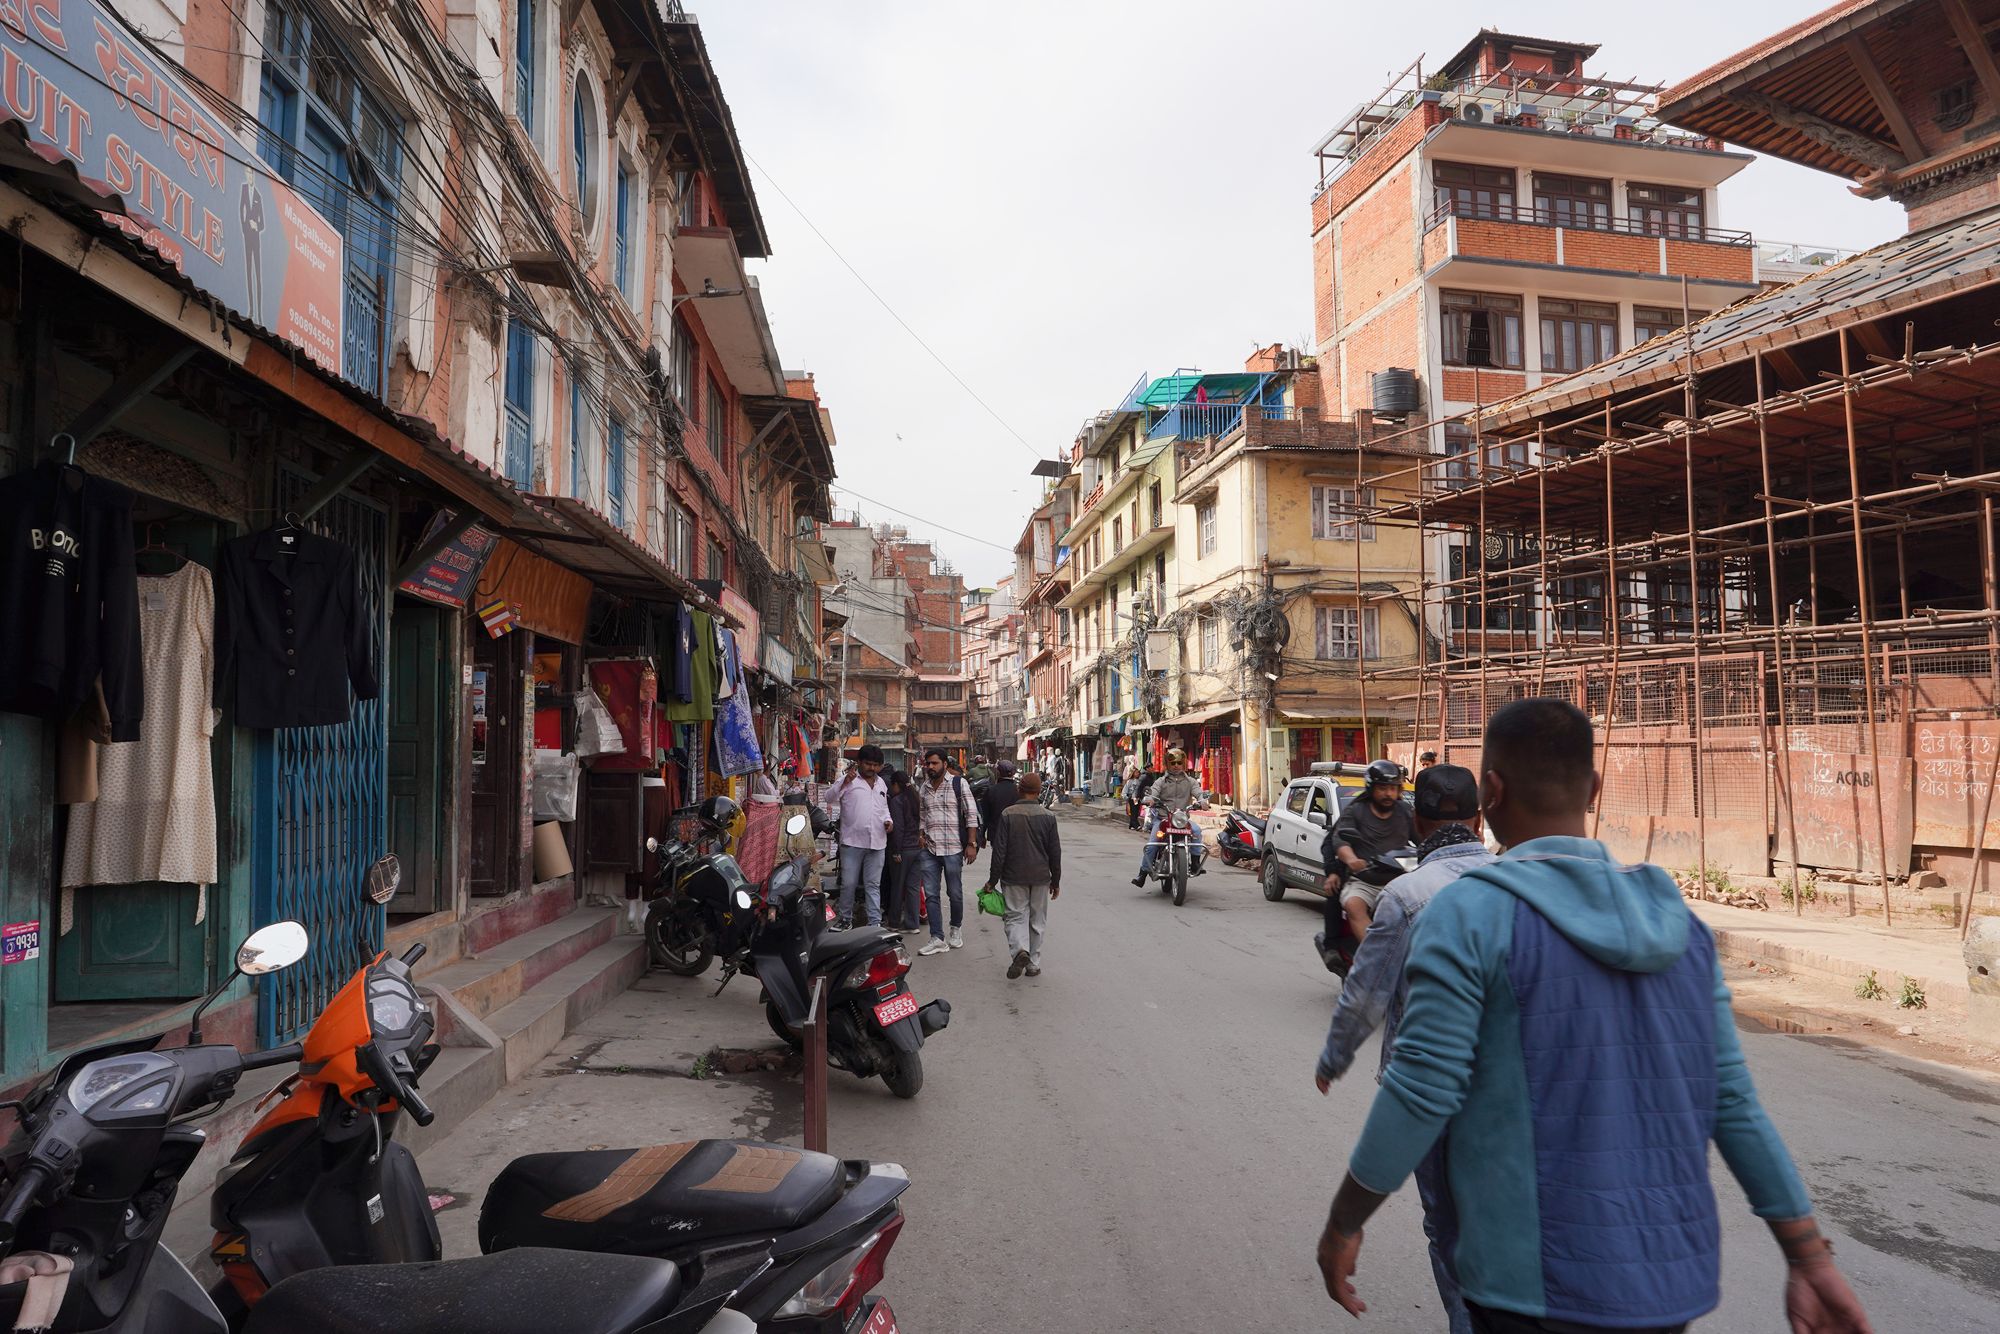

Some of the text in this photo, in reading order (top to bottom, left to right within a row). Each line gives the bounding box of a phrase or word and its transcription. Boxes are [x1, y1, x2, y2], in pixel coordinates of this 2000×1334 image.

[0, 43, 226, 267] UIT STYLE
[284, 202, 336, 261] Mangalbazar
[294, 235, 327, 273] Lalitpur
[308, 302, 320, 322] Ph.
